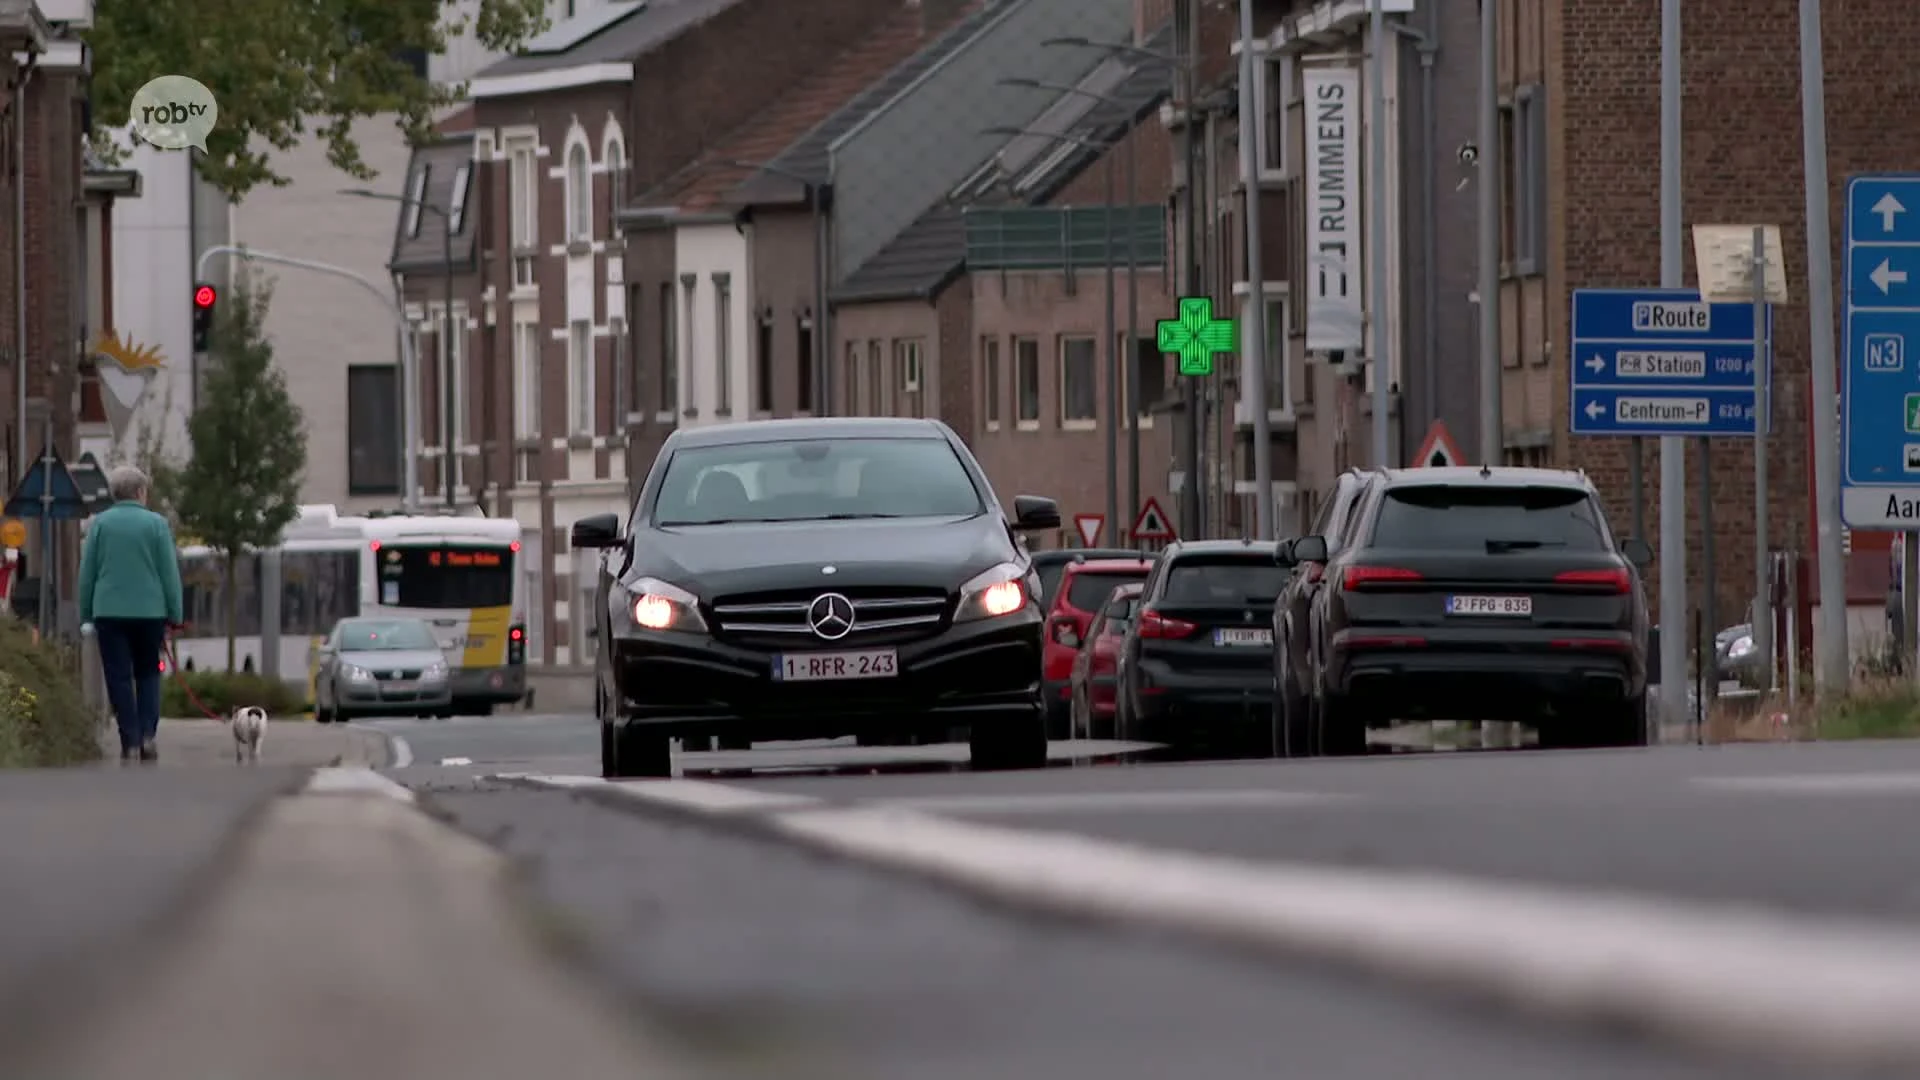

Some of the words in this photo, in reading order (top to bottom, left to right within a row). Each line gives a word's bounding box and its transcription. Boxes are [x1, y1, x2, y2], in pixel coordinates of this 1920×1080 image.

[1318, 83, 1346, 233] RUMMENS
[1653, 305, 1706, 328] Route
[1647, 355, 1702, 373] Station
[1715, 357, 1742, 372] 1200
[1870, 340, 1898, 370] N3
[1619, 400, 1706, 419] Centrum-P
